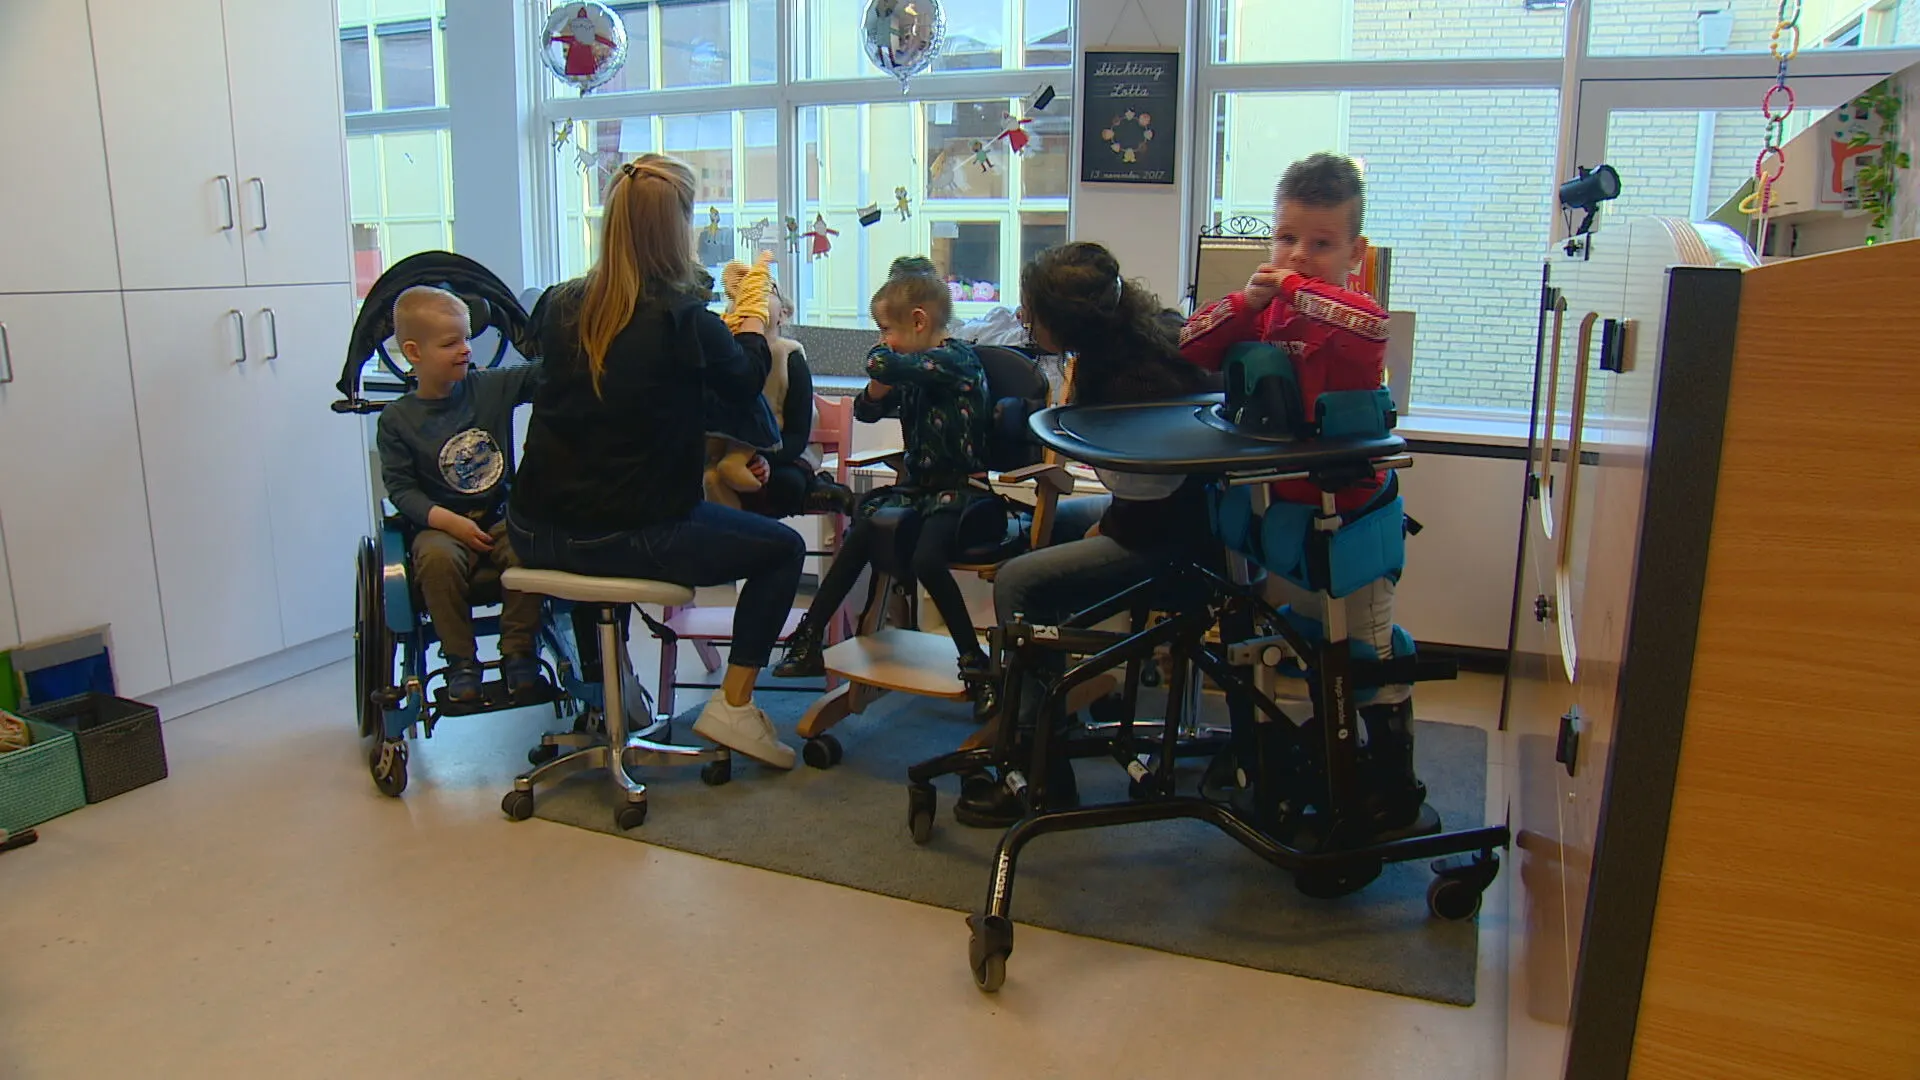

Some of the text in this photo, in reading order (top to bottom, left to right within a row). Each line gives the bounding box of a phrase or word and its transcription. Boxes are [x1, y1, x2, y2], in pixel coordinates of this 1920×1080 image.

[1094, 61, 1164, 80] Stichting
[1110, 83, 1149, 97] Lotta
[1090, 170, 1166, 179] 13 november 2017
[994, 851, 1010, 898] LECKEY
